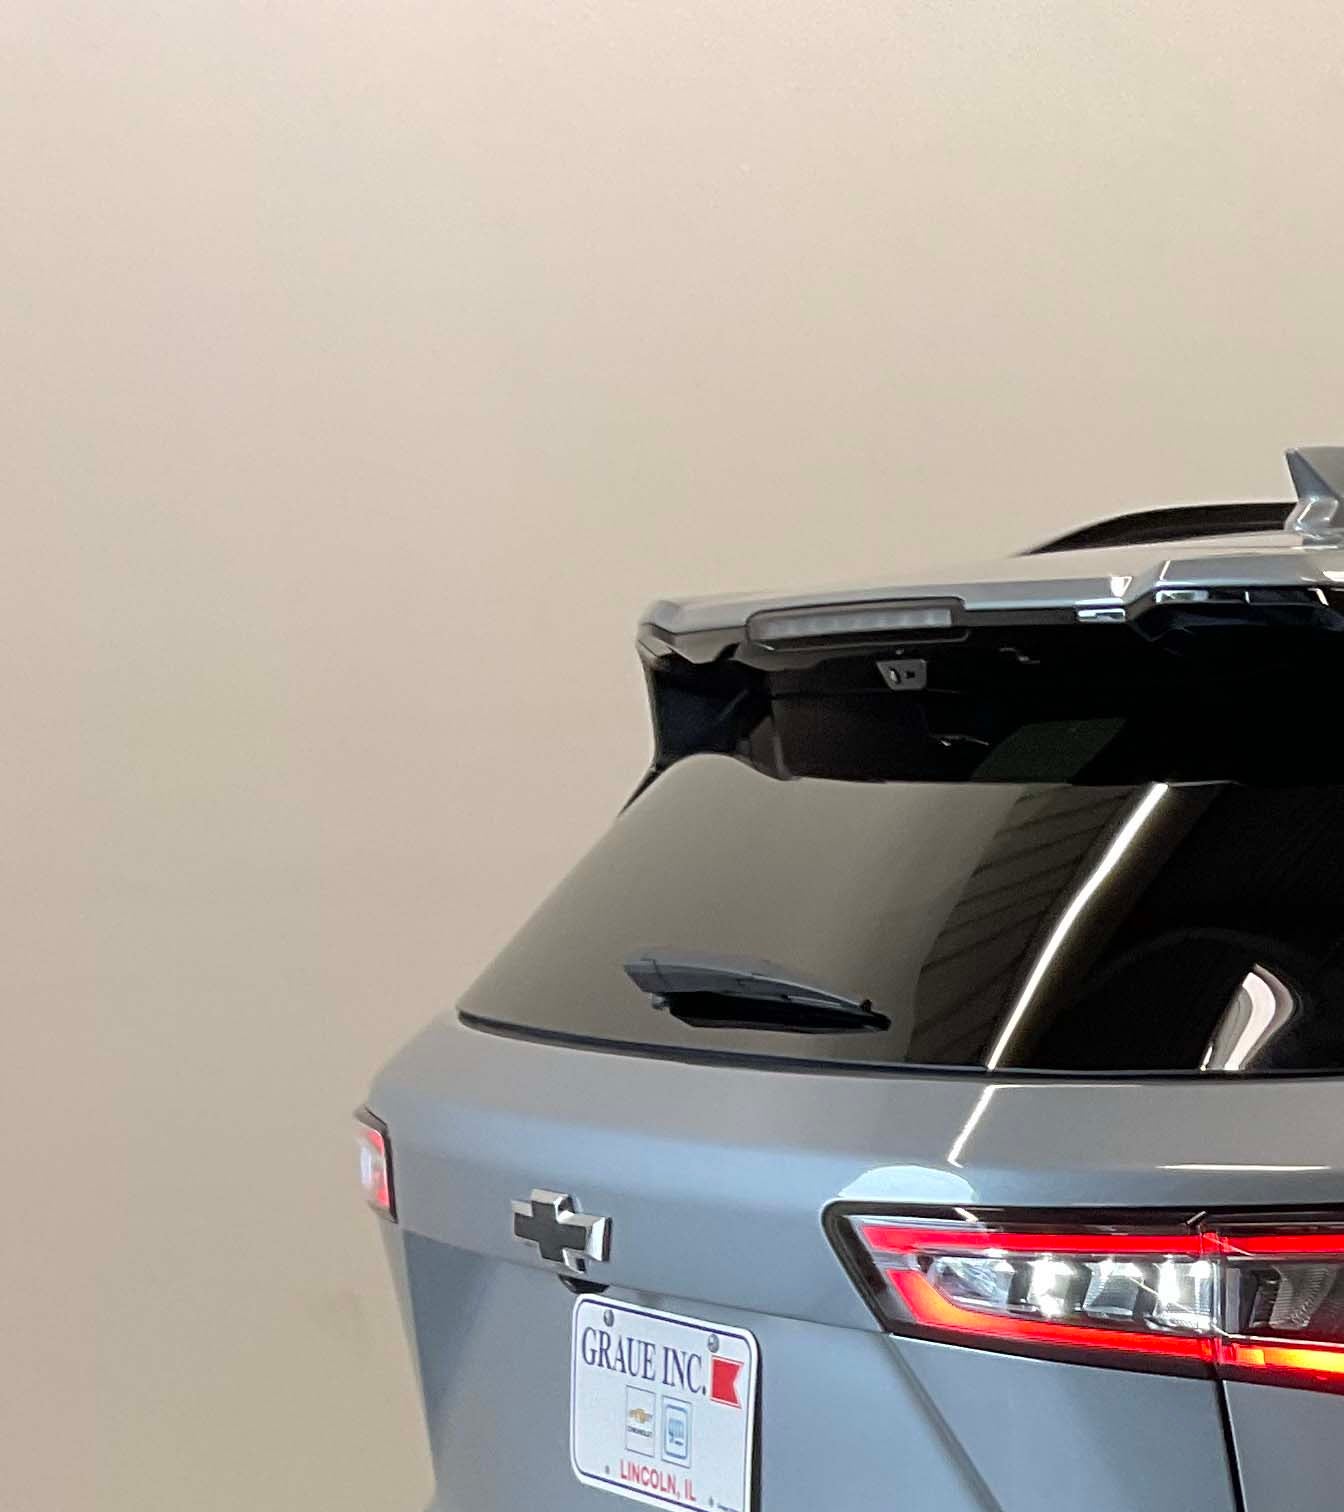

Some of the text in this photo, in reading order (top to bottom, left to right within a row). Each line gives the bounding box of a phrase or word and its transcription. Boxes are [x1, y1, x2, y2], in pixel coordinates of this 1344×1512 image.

[582, 1326, 707, 1396] GRAUE INC.
[620, 1459, 697, 1501] LINCOLN, IL
